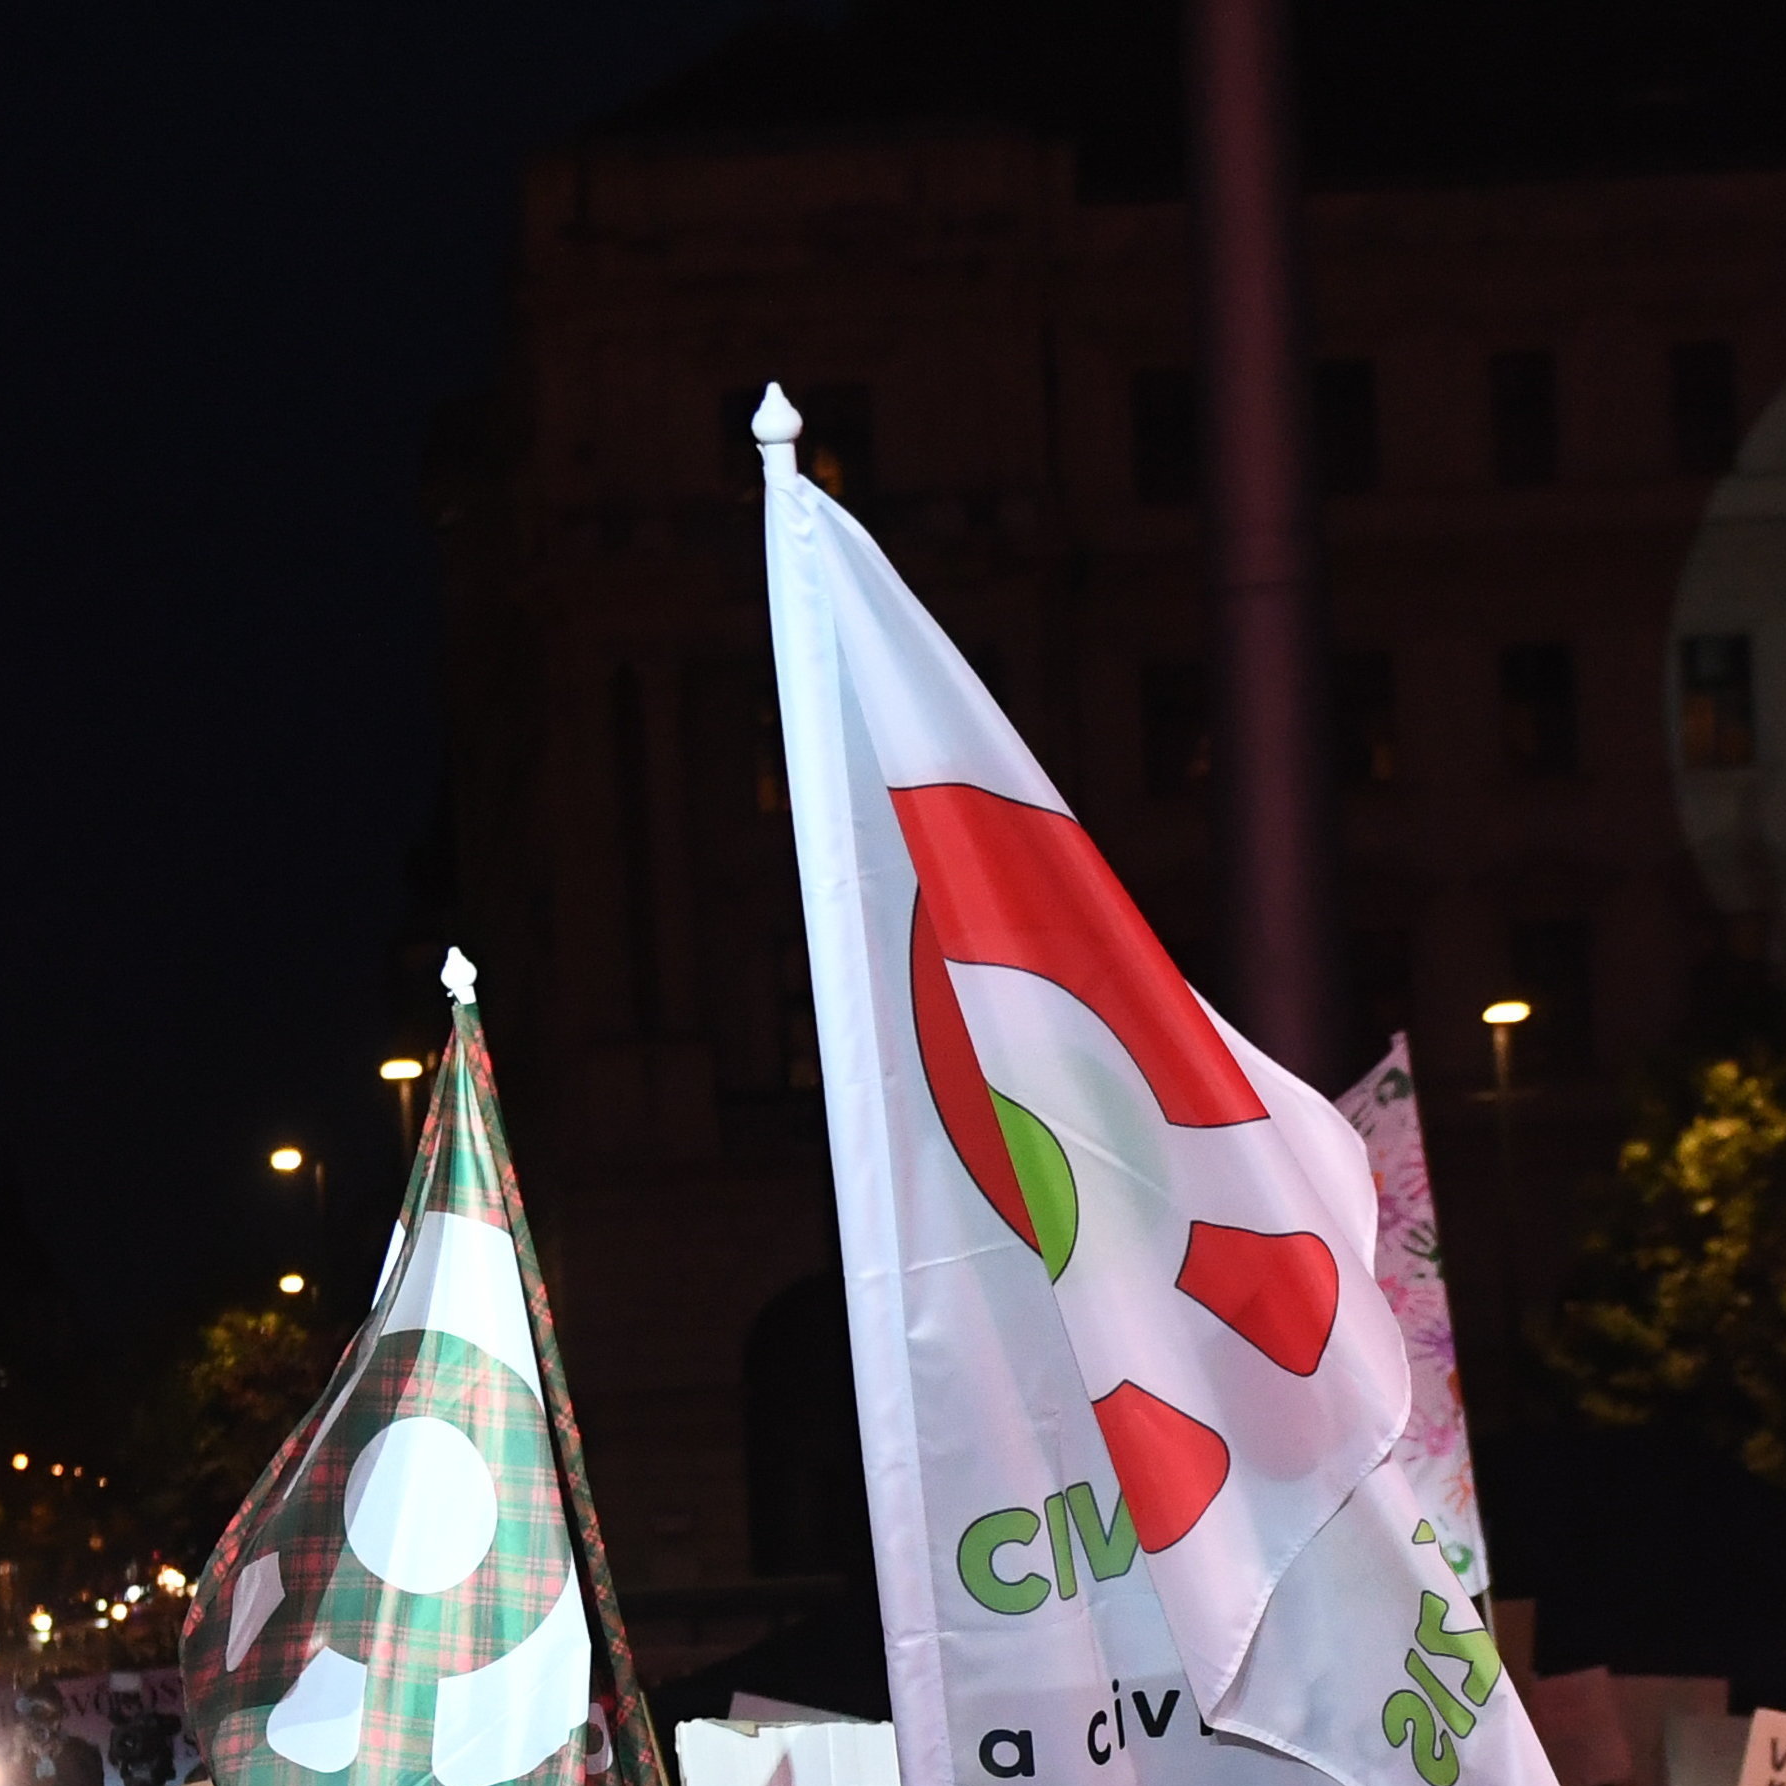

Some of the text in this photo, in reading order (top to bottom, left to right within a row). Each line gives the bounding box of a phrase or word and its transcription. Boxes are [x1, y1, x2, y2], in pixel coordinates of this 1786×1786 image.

[956, 1481, 1141, 1616] CIV
[978, 1678, 1213, 1779] a civ
